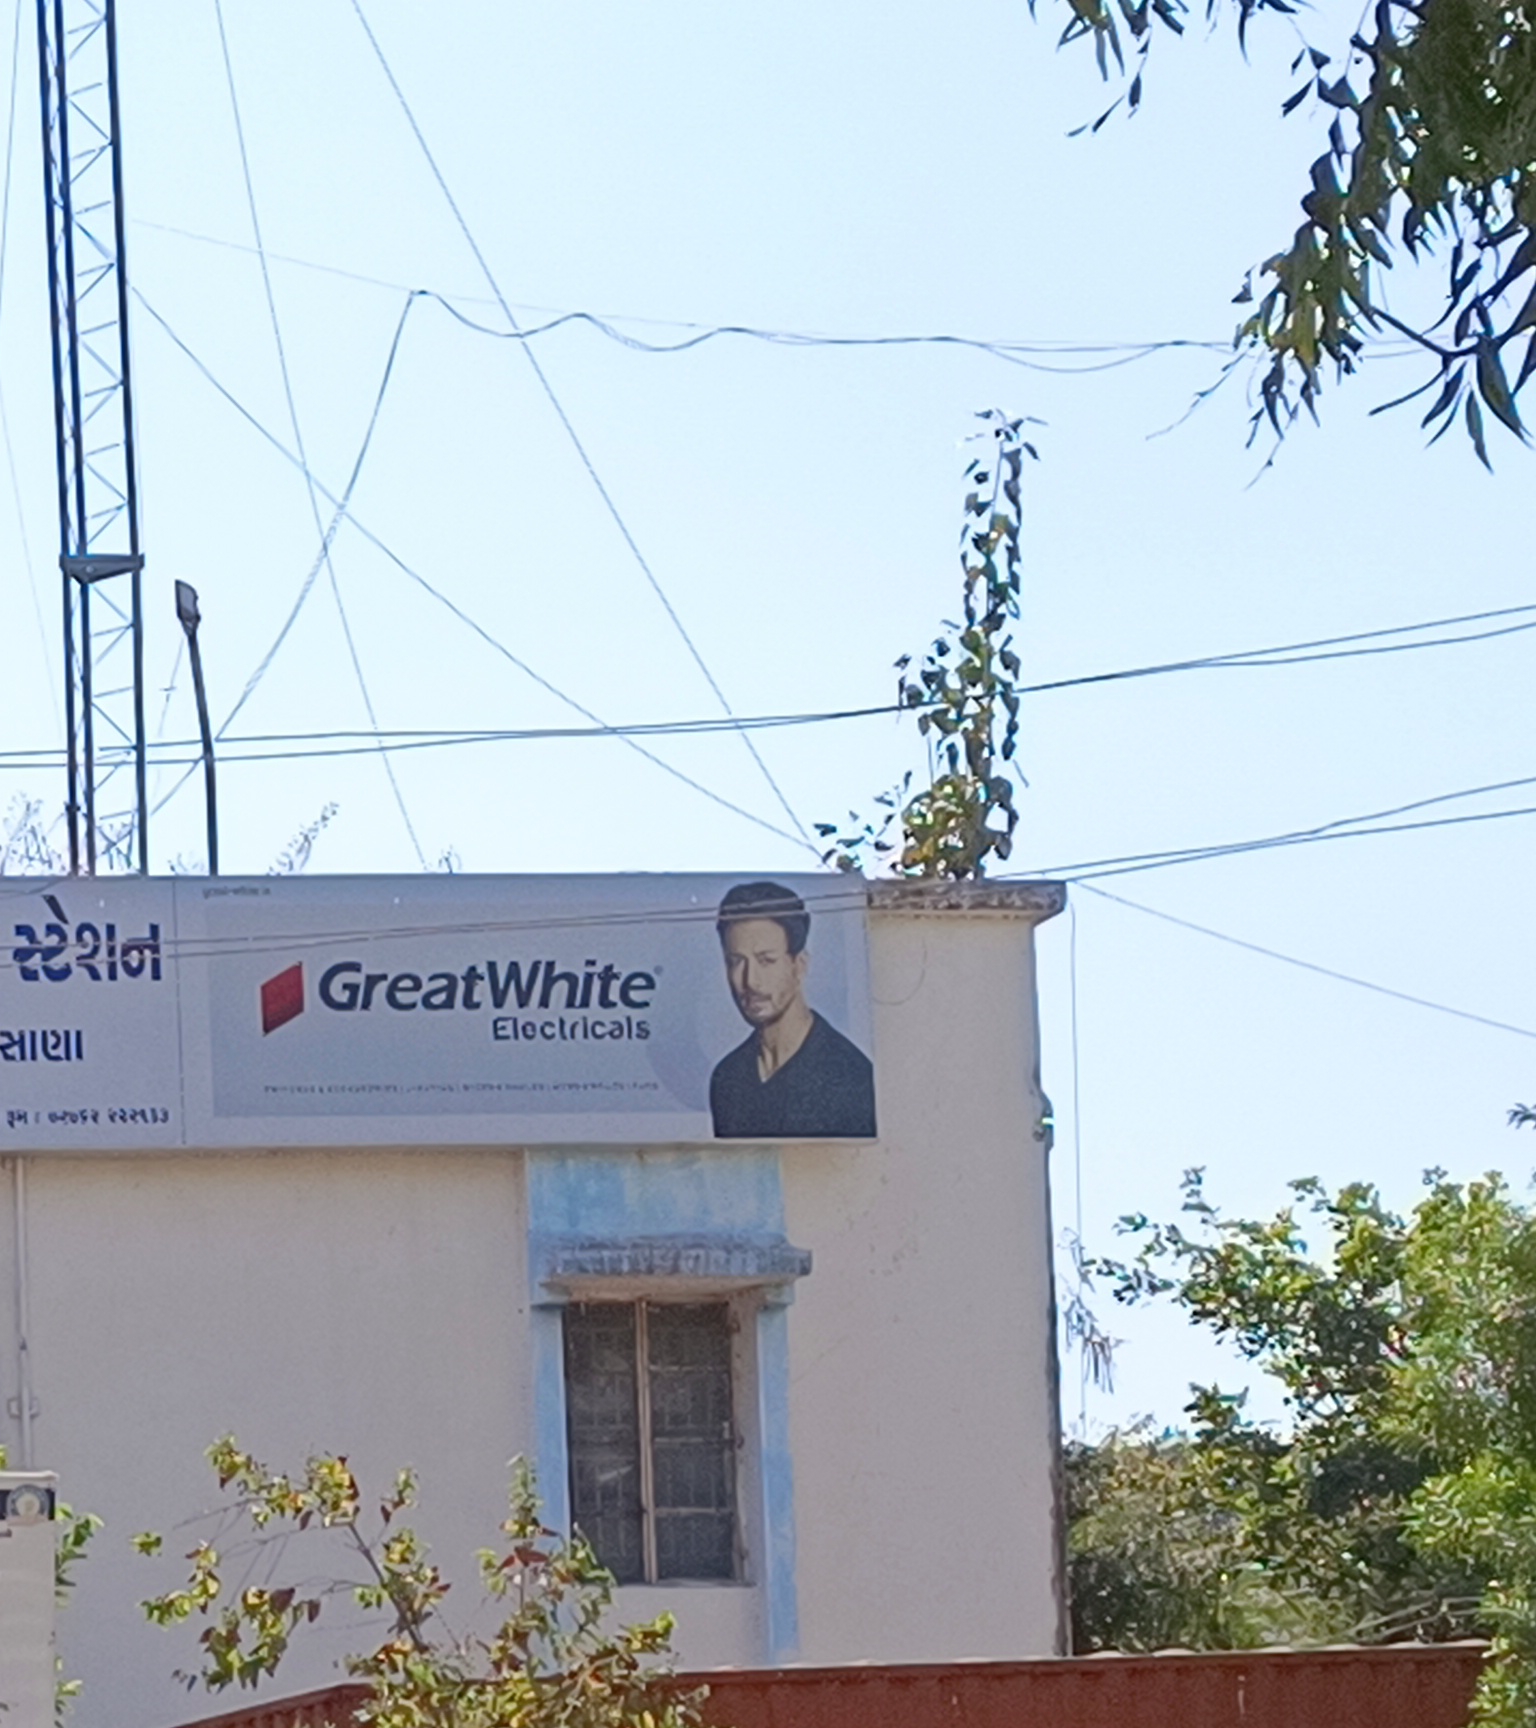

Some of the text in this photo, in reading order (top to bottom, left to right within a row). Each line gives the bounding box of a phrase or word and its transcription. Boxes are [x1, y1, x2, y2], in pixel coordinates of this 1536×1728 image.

[11, 894, 163, 983] સ્ટેશન
[319, 960, 657, 1012] GreatWhite
[492, 1016, 651, 1041] Electricals
